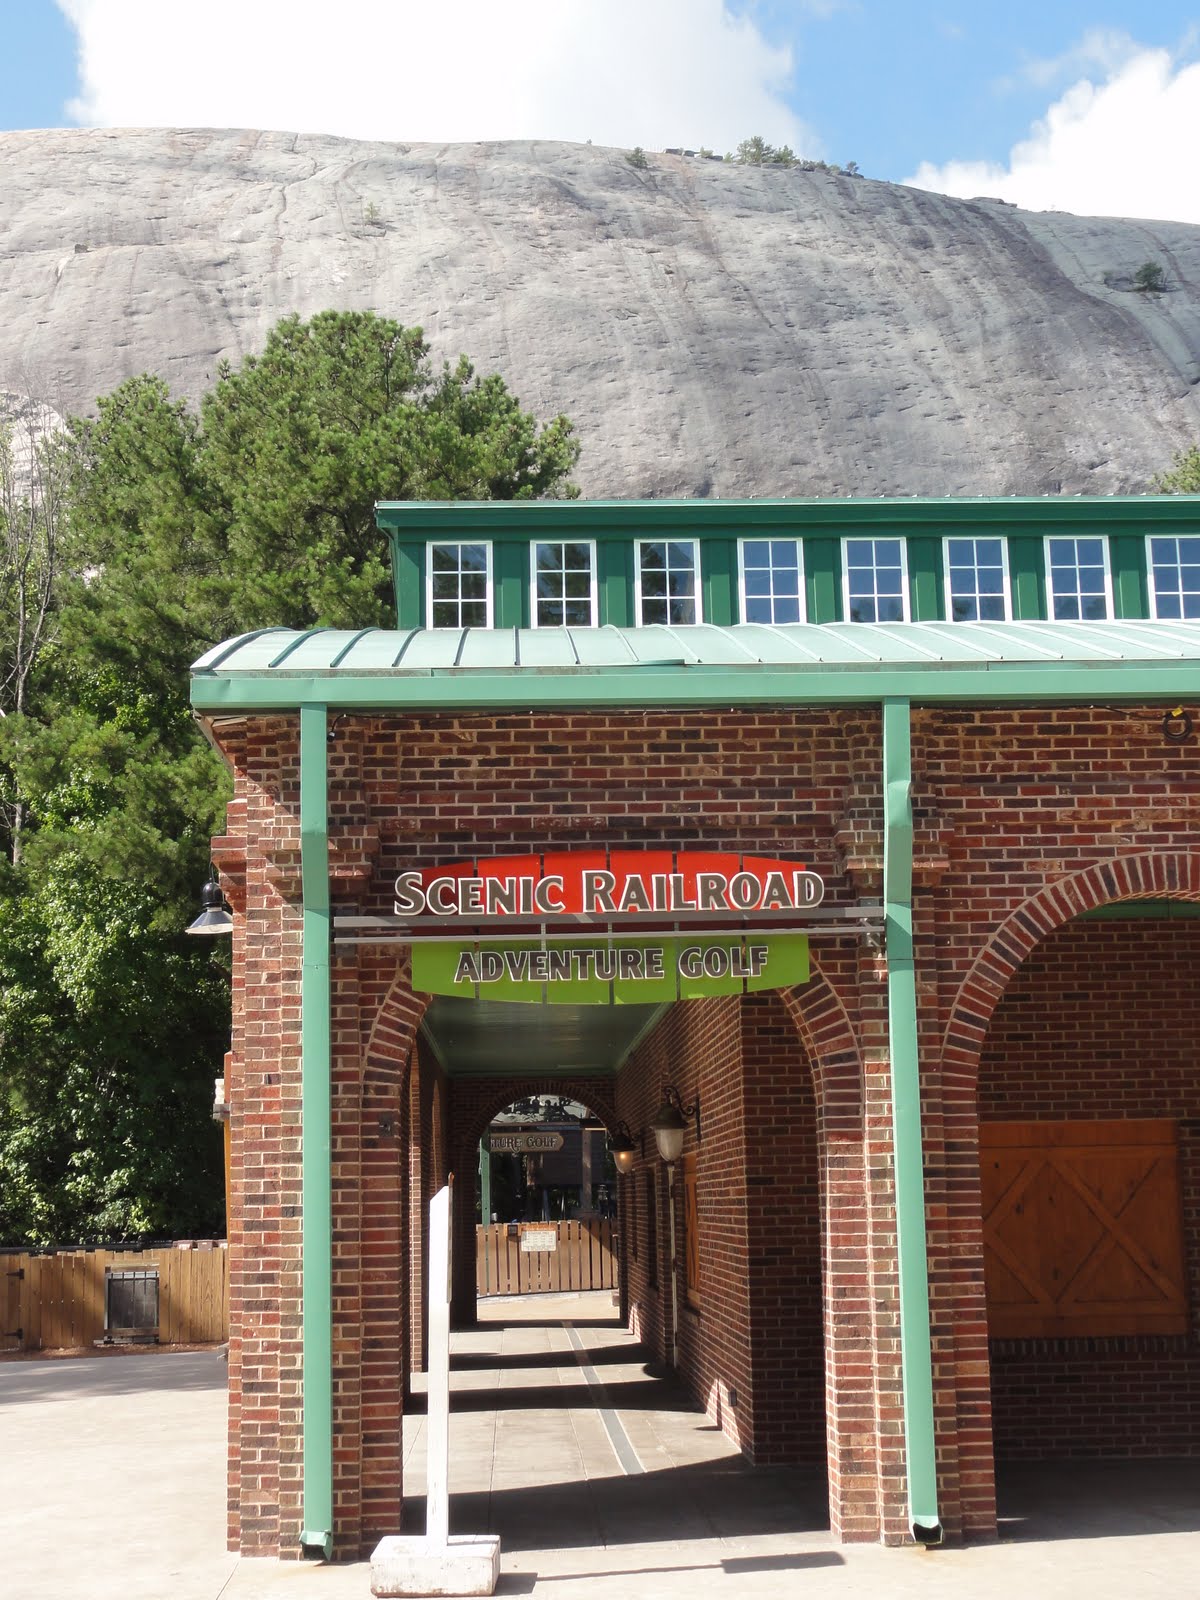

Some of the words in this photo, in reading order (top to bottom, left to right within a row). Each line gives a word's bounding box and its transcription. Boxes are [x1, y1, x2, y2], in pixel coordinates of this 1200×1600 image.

[394, 872, 565, 915] SCENIC
[582, 870, 825, 912] RAILROAD
[453, 948, 665, 983] ADVENTURE
[679, 946, 769, 978] GOLF
[526, 1136, 558, 1148] GOLF
